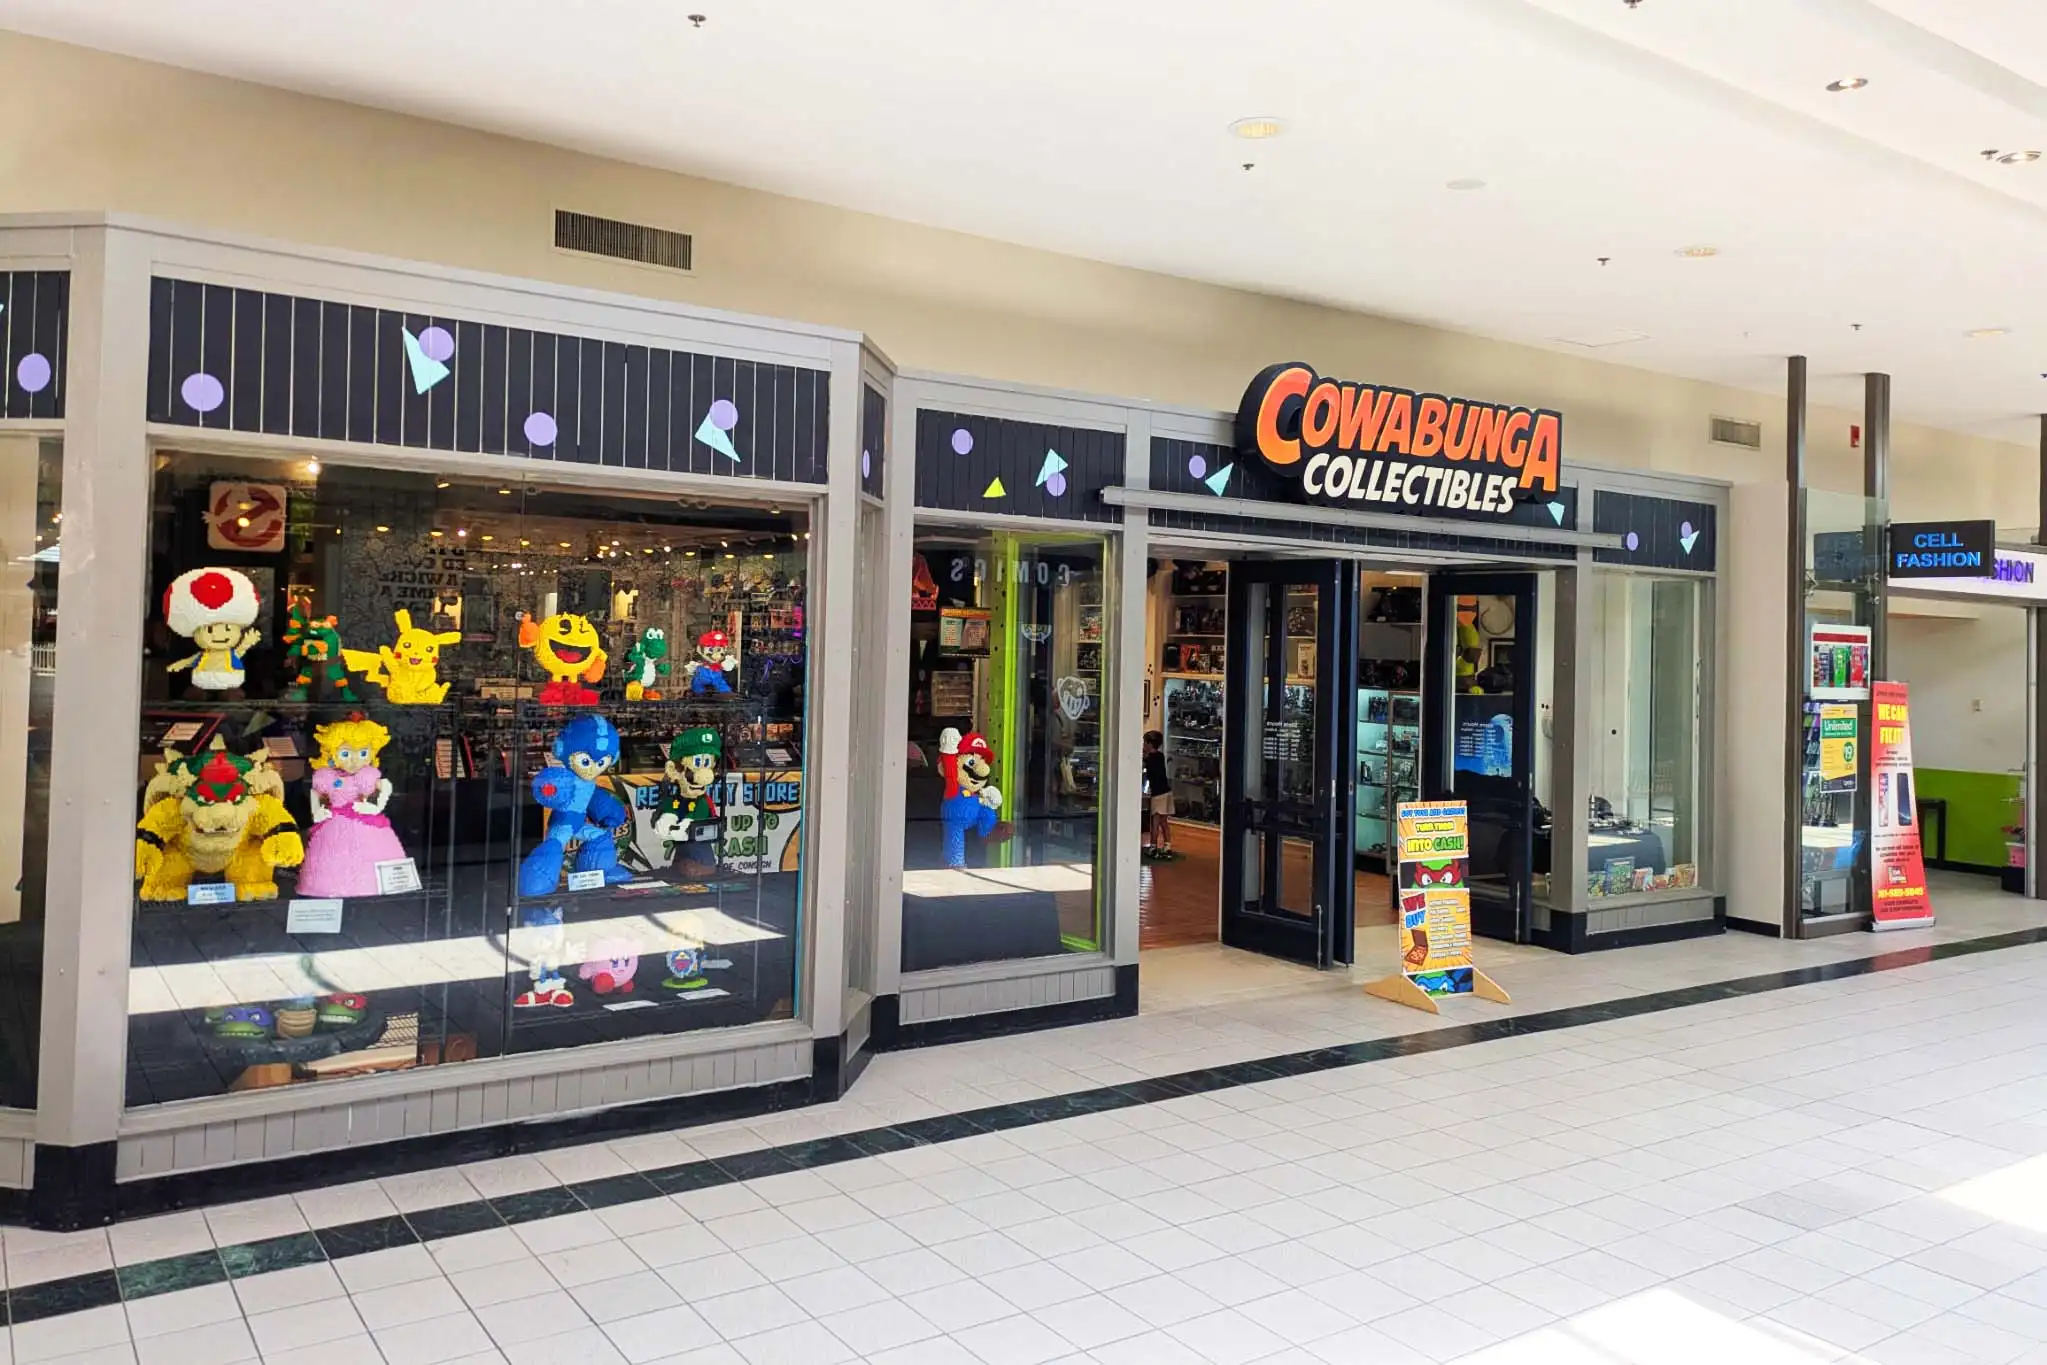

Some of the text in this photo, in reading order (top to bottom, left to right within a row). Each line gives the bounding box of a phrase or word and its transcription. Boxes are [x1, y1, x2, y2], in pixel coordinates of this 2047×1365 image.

[1257, 367, 1559, 491] COWABUNGA
[1304, 453, 1519, 514] COLLECTIBLES
[1913, 533, 1964, 548] CELL
[1896, 551, 1981, 568] FASHION
[1991, 558, 2034, 584] SHION
[731, 815, 753, 831] UP
[1407, 835, 1464, 852] INTO CASH!
[1403, 893, 1426, 912] WE
[1405, 910, 1426, 929] BUY
